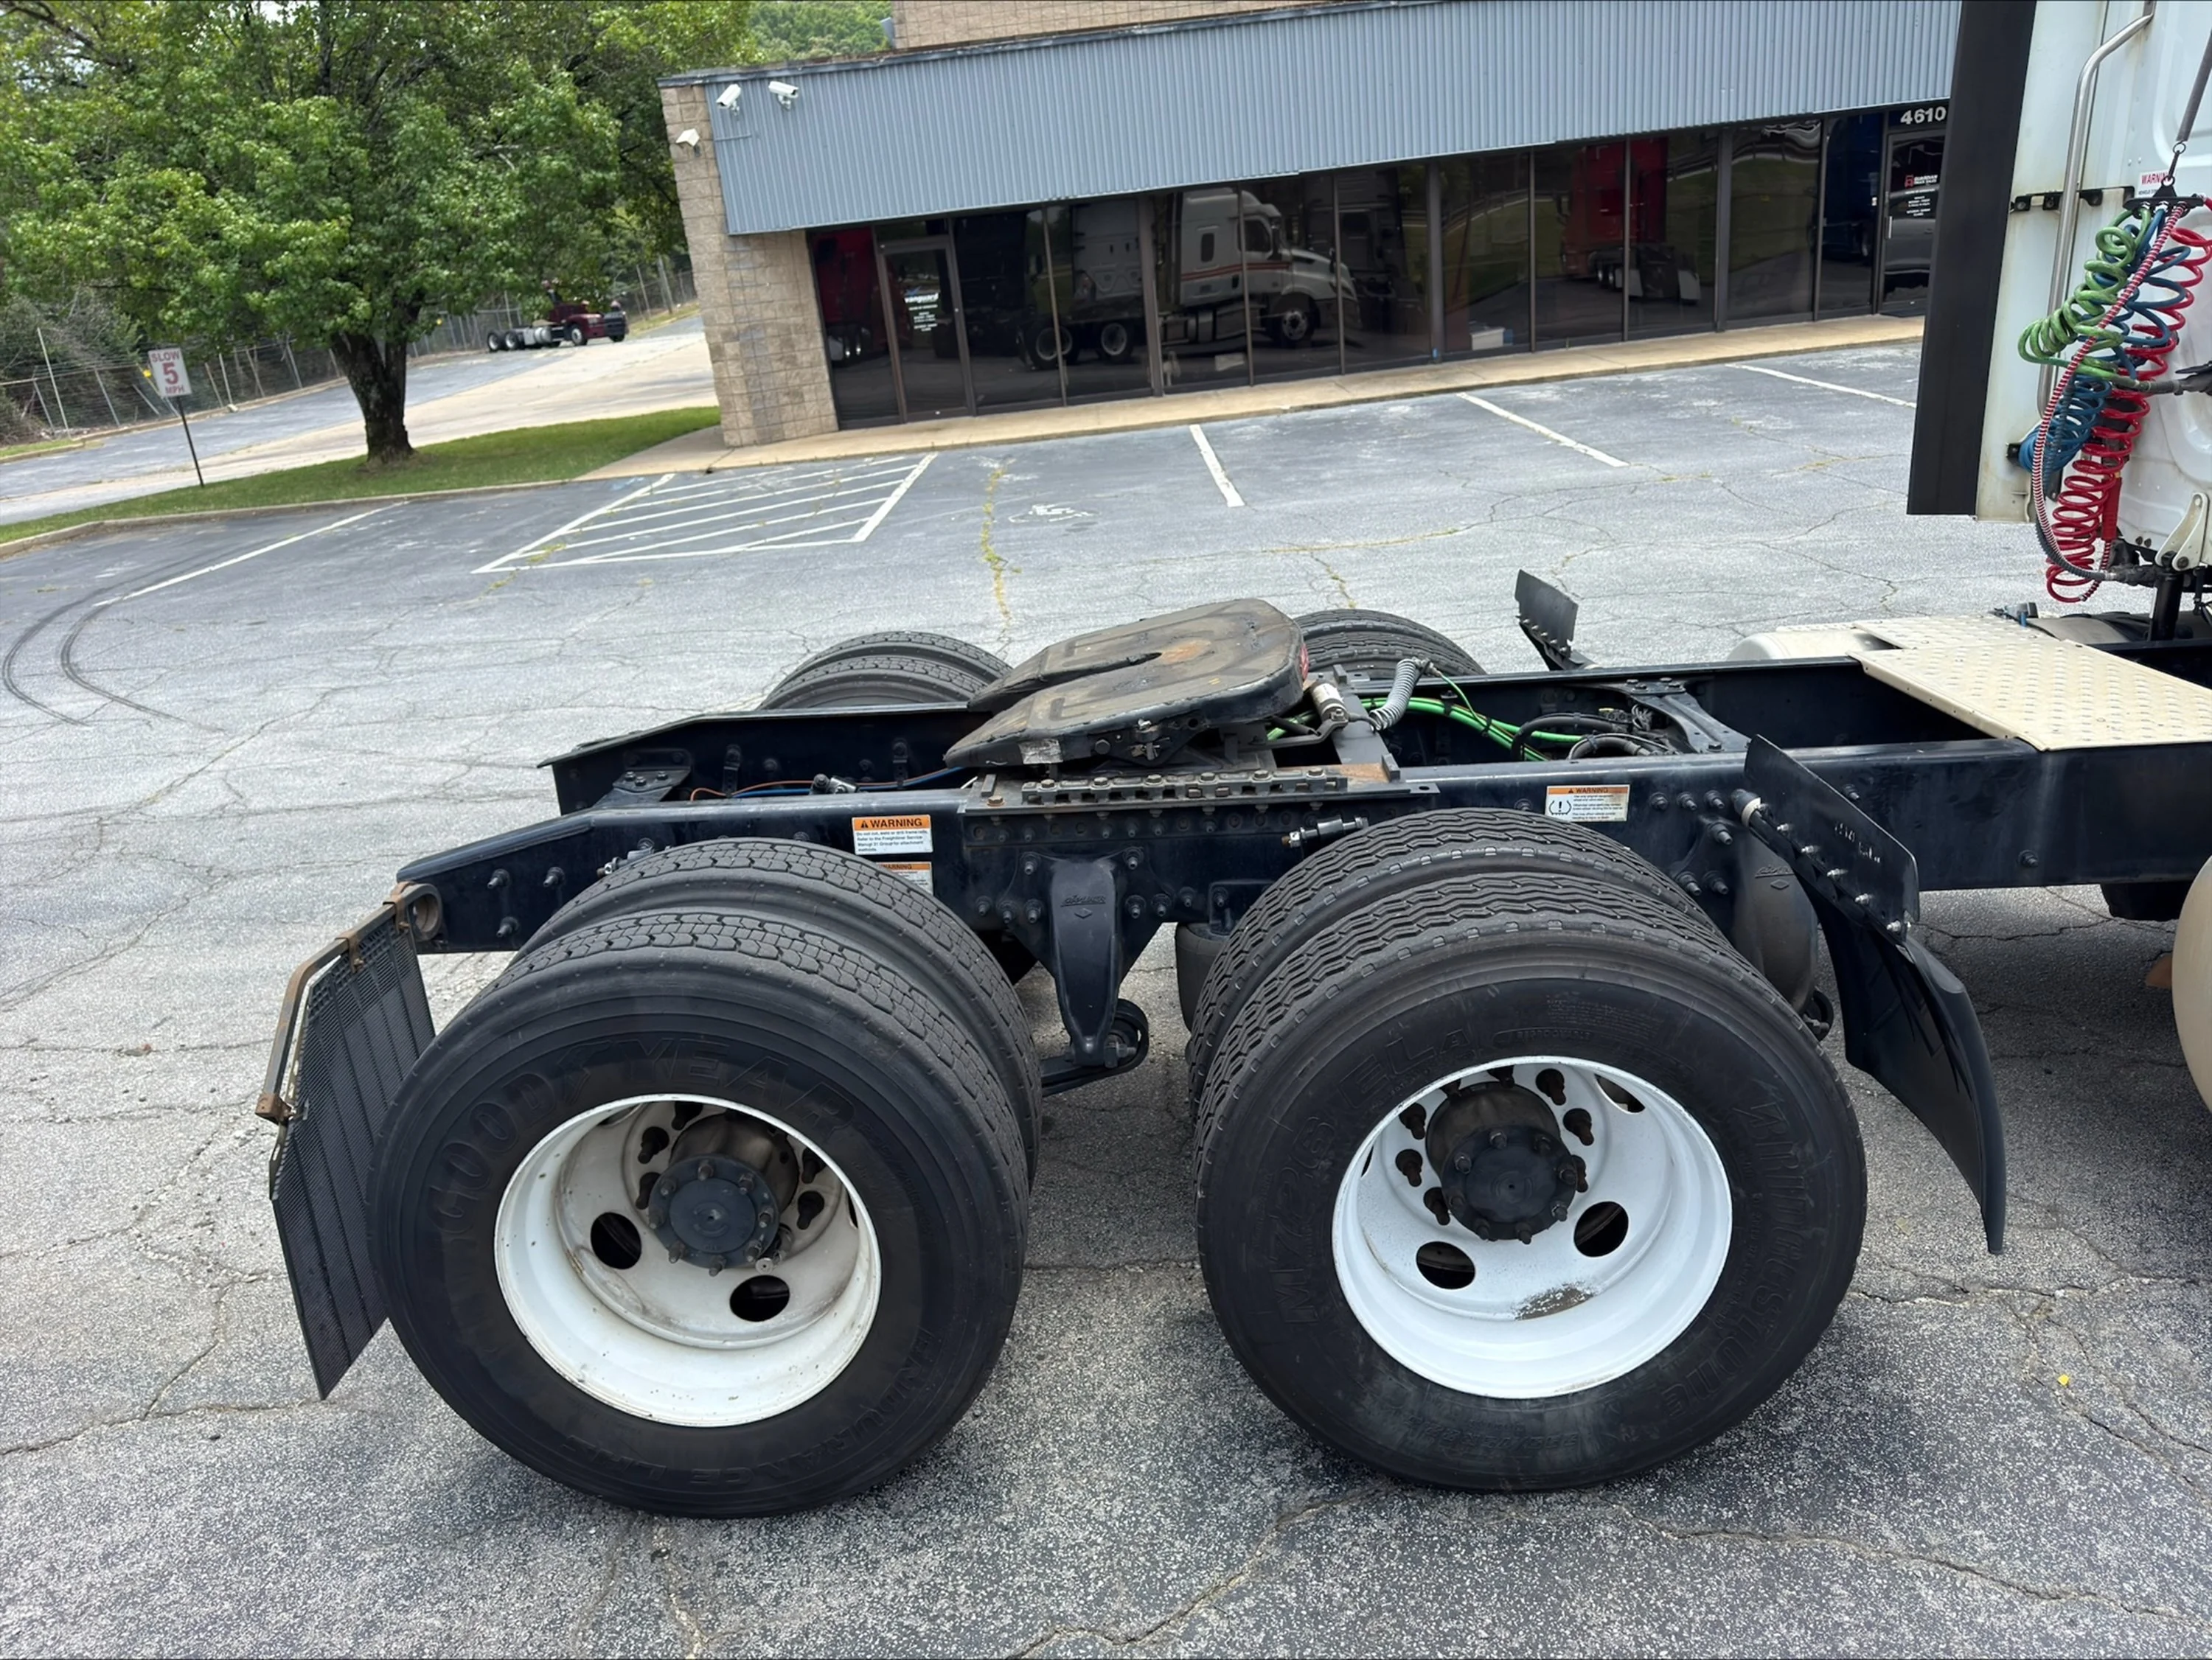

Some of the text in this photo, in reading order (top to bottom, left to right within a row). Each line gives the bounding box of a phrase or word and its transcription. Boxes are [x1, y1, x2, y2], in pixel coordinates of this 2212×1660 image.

[1900, 106, 1947, 125] 4610
[904, 292, 939, 304] vanguard
[151, 351, 180, 362] SLOW
[162, 362, 178, 385] 5
[165, 386, 184, 394] MPH
[870, 817, 922, 829] WARNING
[1268, 1116, 1336, 1327] M726
